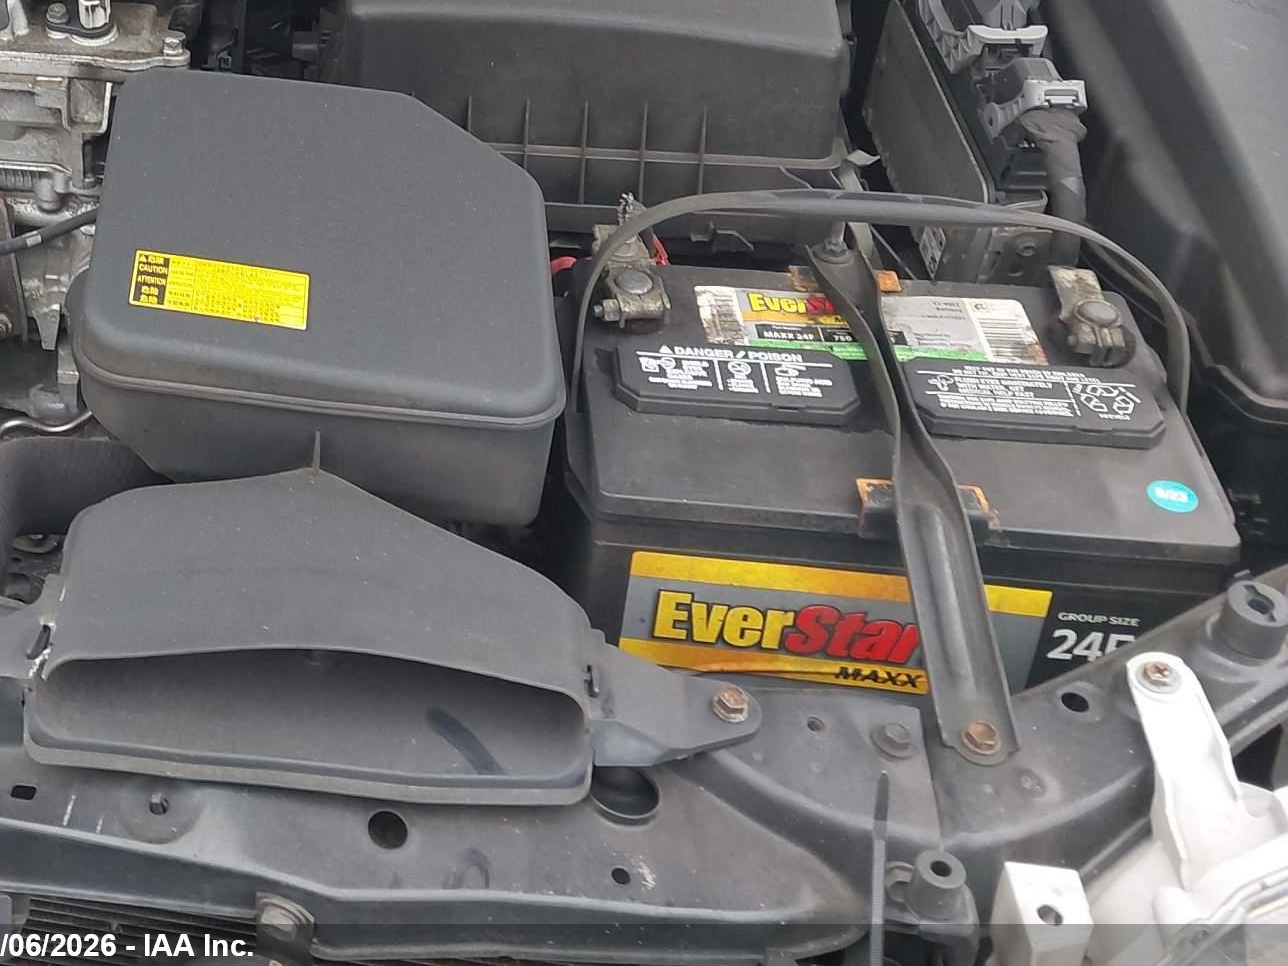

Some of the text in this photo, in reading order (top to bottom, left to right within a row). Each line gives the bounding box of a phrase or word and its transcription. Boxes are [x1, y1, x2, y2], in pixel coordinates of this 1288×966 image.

[138, 263, 168, 275] CAUTION
[137, 275, 166, 286] ATTENTION
[674, 346, 737, 359] DANGER
[748, 350, 804, 363] POISON
[1057, 612, 1141, 627] GROUP SIZE
[835, 666, 924, 689] MAXX
